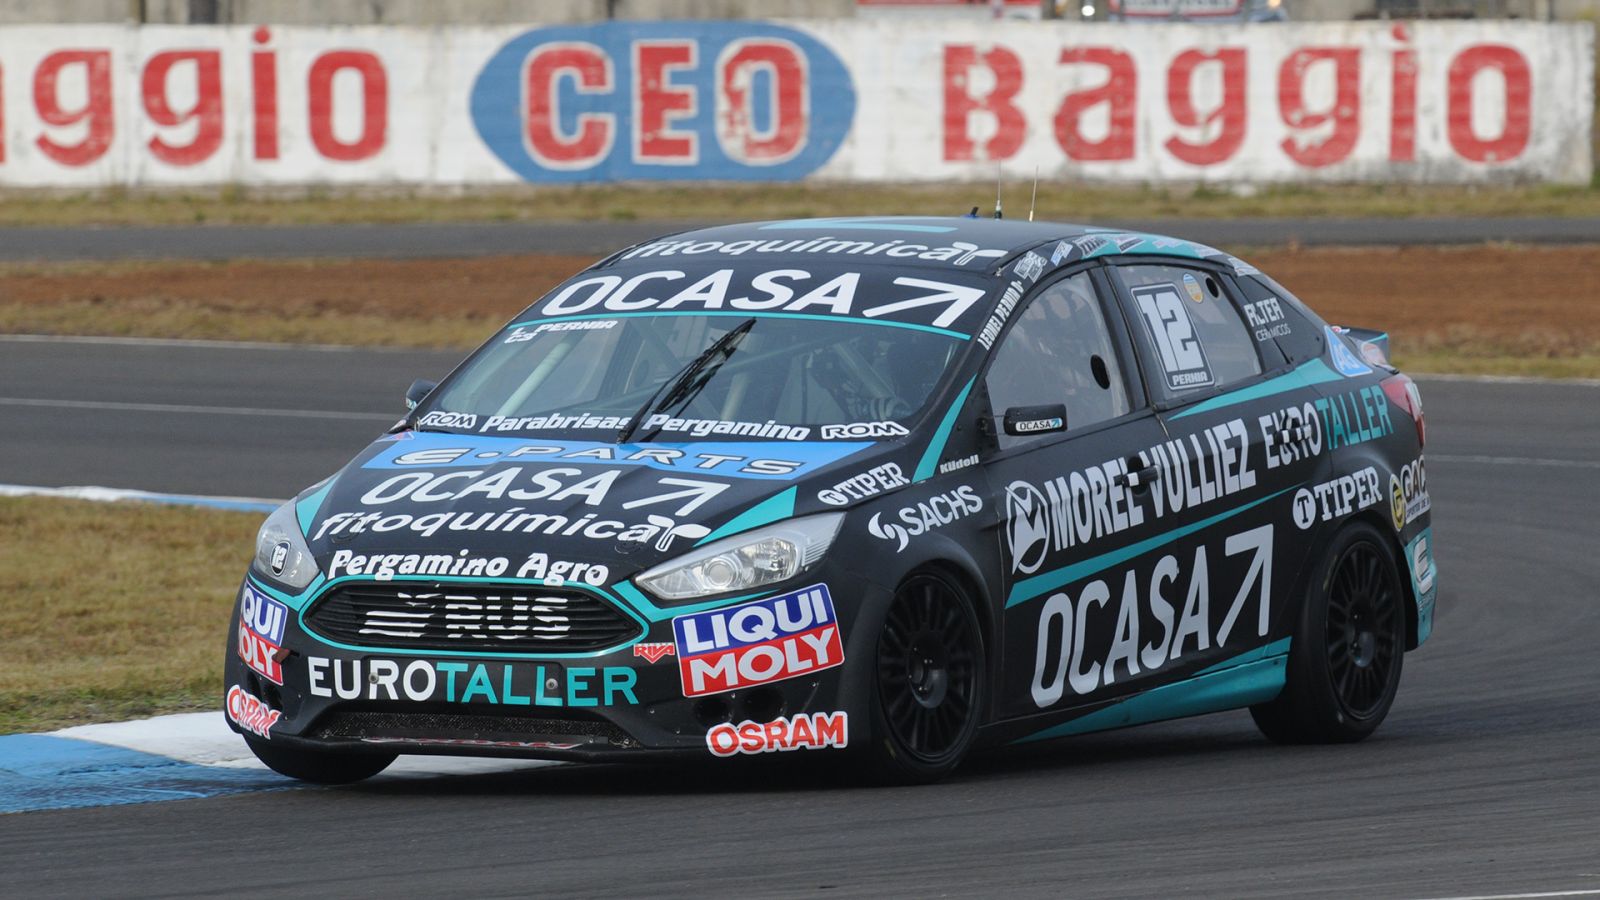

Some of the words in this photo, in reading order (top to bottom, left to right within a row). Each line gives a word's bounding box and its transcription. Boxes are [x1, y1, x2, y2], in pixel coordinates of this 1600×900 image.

[0, 26, 389, 168] ggio
[522, 38, 810, 168] CEO
[942, 24, 1532, 168] Baggio
[621, 236, 957, 262] fitoquímica
[542, 268, 861, 316] OCASA
[535, 320, 618, 333] PERNIA
[1136, 291, 1205, 373] 12
[1172, 370, 1208, 386] PERNIA
[420, 411, 477, 429] ROM
[479, 413, 632, 433] Parabrisas
[641, 414, 811, 441] Pergamino
[821, 421, 910, 439] ROM
[1020, 419, 1051, 430] OCASA
[361, 467, 621, 506] OCASA
[833, 462, 911, 500] TIPER
[1045, 457, 1144, 551] MOREL
[1140, 418, 1256, 518] VULLIEZ
[1313, 466, 1383, 521] TIPER
[312, 507, 661, 543] fitoquímica
[898, 485, 983, 535] SACHS
[270, 545, 287, 571] 12
[328, 549, 509, 581] Pergamino
[516, 552, 609, 586] Agro
[682, 589, 829, 653] LIQUI
[1031, 545, 1210, 708] OCASA
[308, 656, 639, 707] EUROTALLER
[690, 627, 835, 692] MOLY
[228, 686, 280, 738] OSRAM
[708, 713, 846, 755] OSRAM
